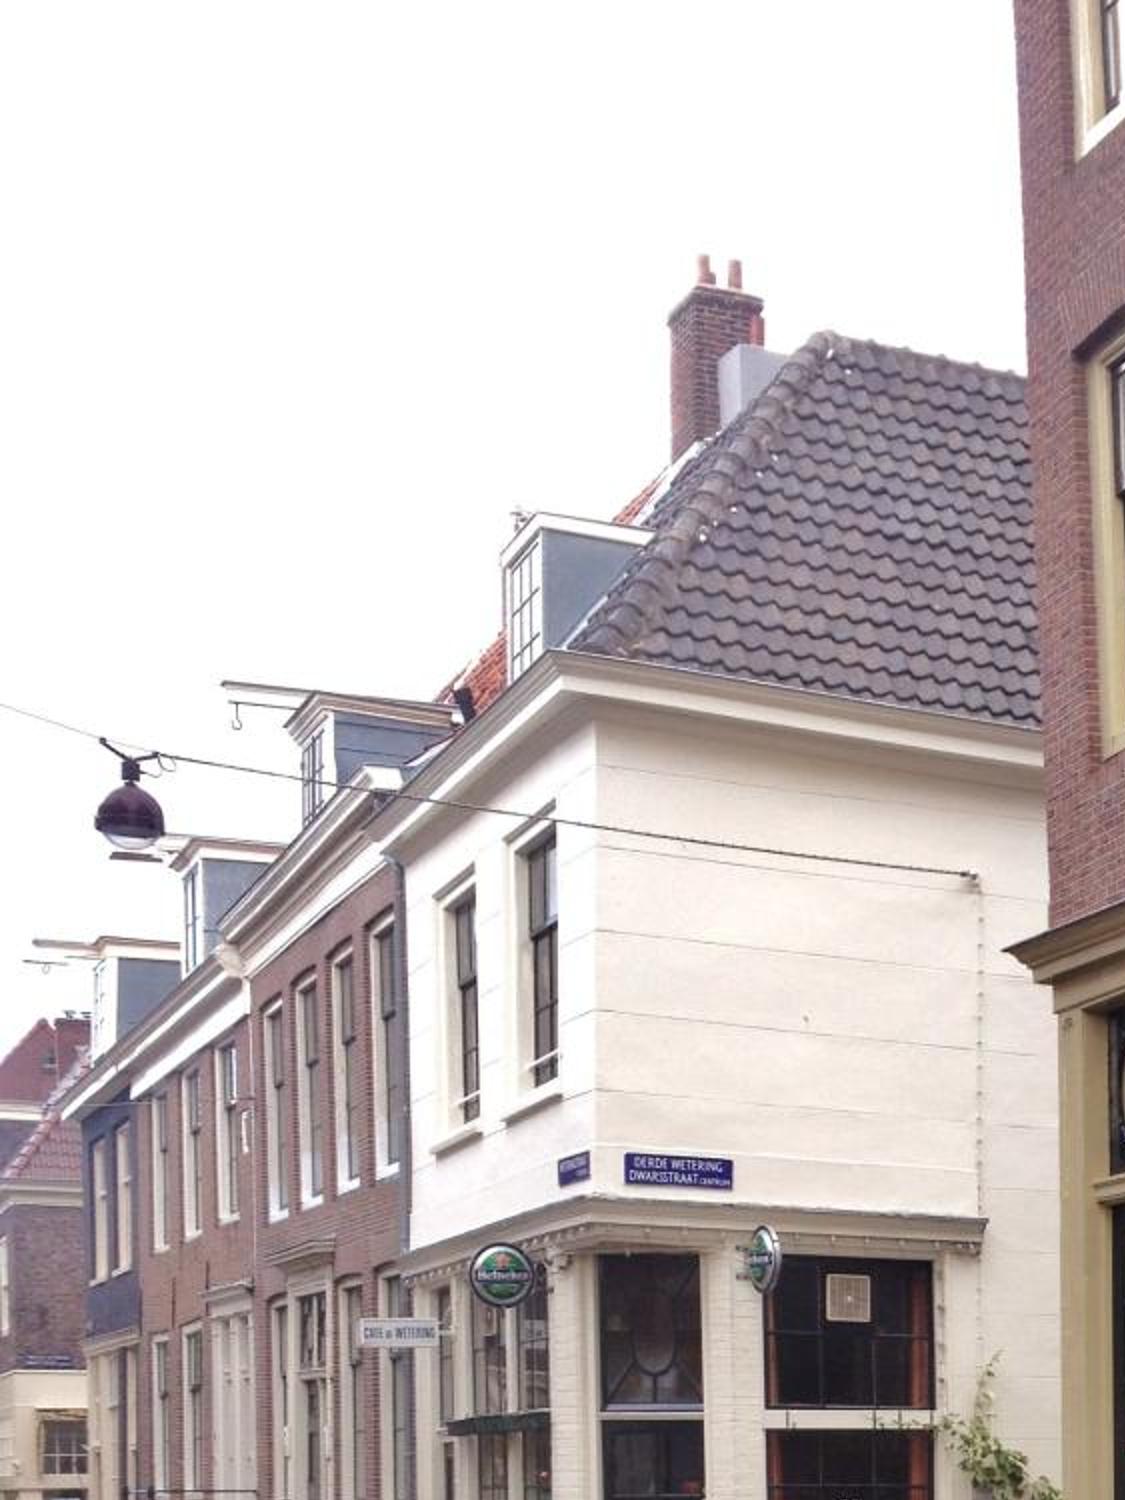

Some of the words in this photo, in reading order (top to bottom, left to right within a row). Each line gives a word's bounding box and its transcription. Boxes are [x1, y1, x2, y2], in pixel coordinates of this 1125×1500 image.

[634, 1156, 668, 1169] DERDE
[671, 1159, 723, 1173] WETERING
[628, 1169, 699, 1183] DWARSSTRAAT
[478, 1270, 530, 1281] Heineken
[395, 1327, 435, 1339] WETERING
